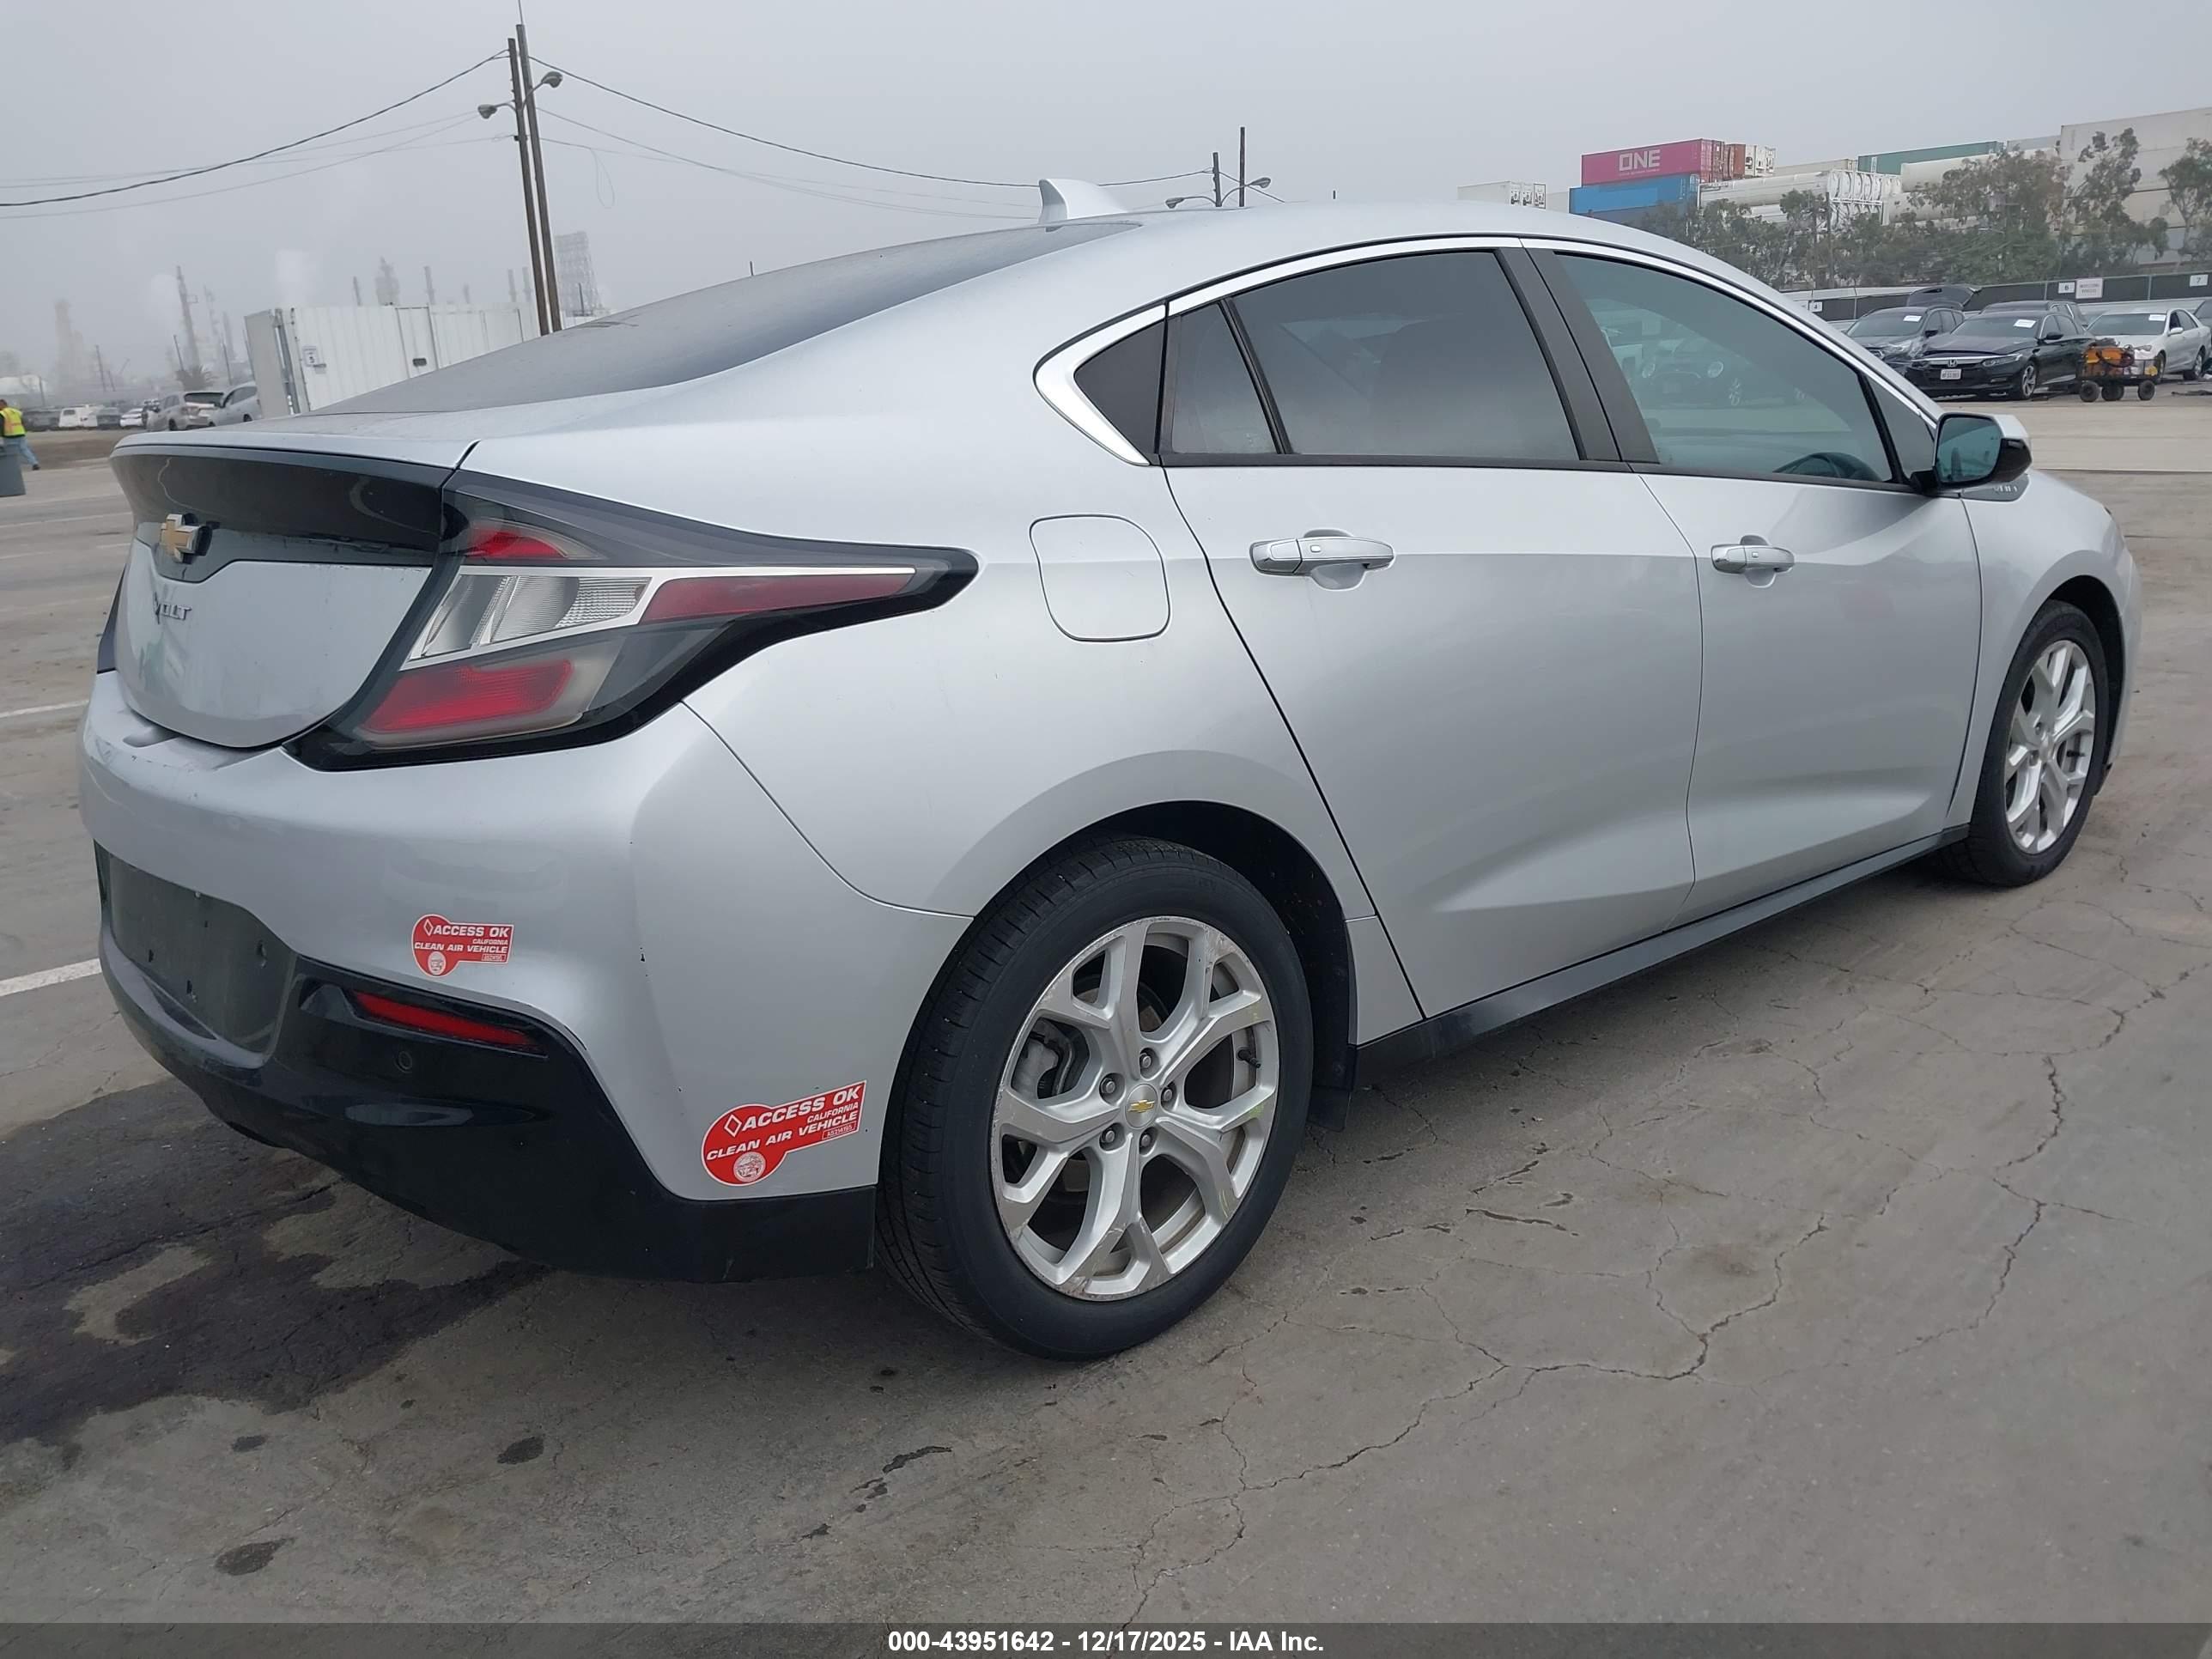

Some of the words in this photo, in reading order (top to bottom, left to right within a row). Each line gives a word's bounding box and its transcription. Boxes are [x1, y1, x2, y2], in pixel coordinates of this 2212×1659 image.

[1619, 149, 1661, 172] ONE
[433, 925, 484, 937] ACCESS
[489, 927, 510, 938] OK
[415, 942, 445, 951] CLEAN
[447, 944, 464, 952] AIR
[741, 1096, 825, 1132] ACCESS
[832, 1086, 861, 1106] OK
[806, 1102, 859, 1124] CALIFORNIA
[707, 1139, 761, 1162] CLEAN
[765, 1131, 793, 1146] AIR
[799, 1110, 858, 1137] VEHICLE
